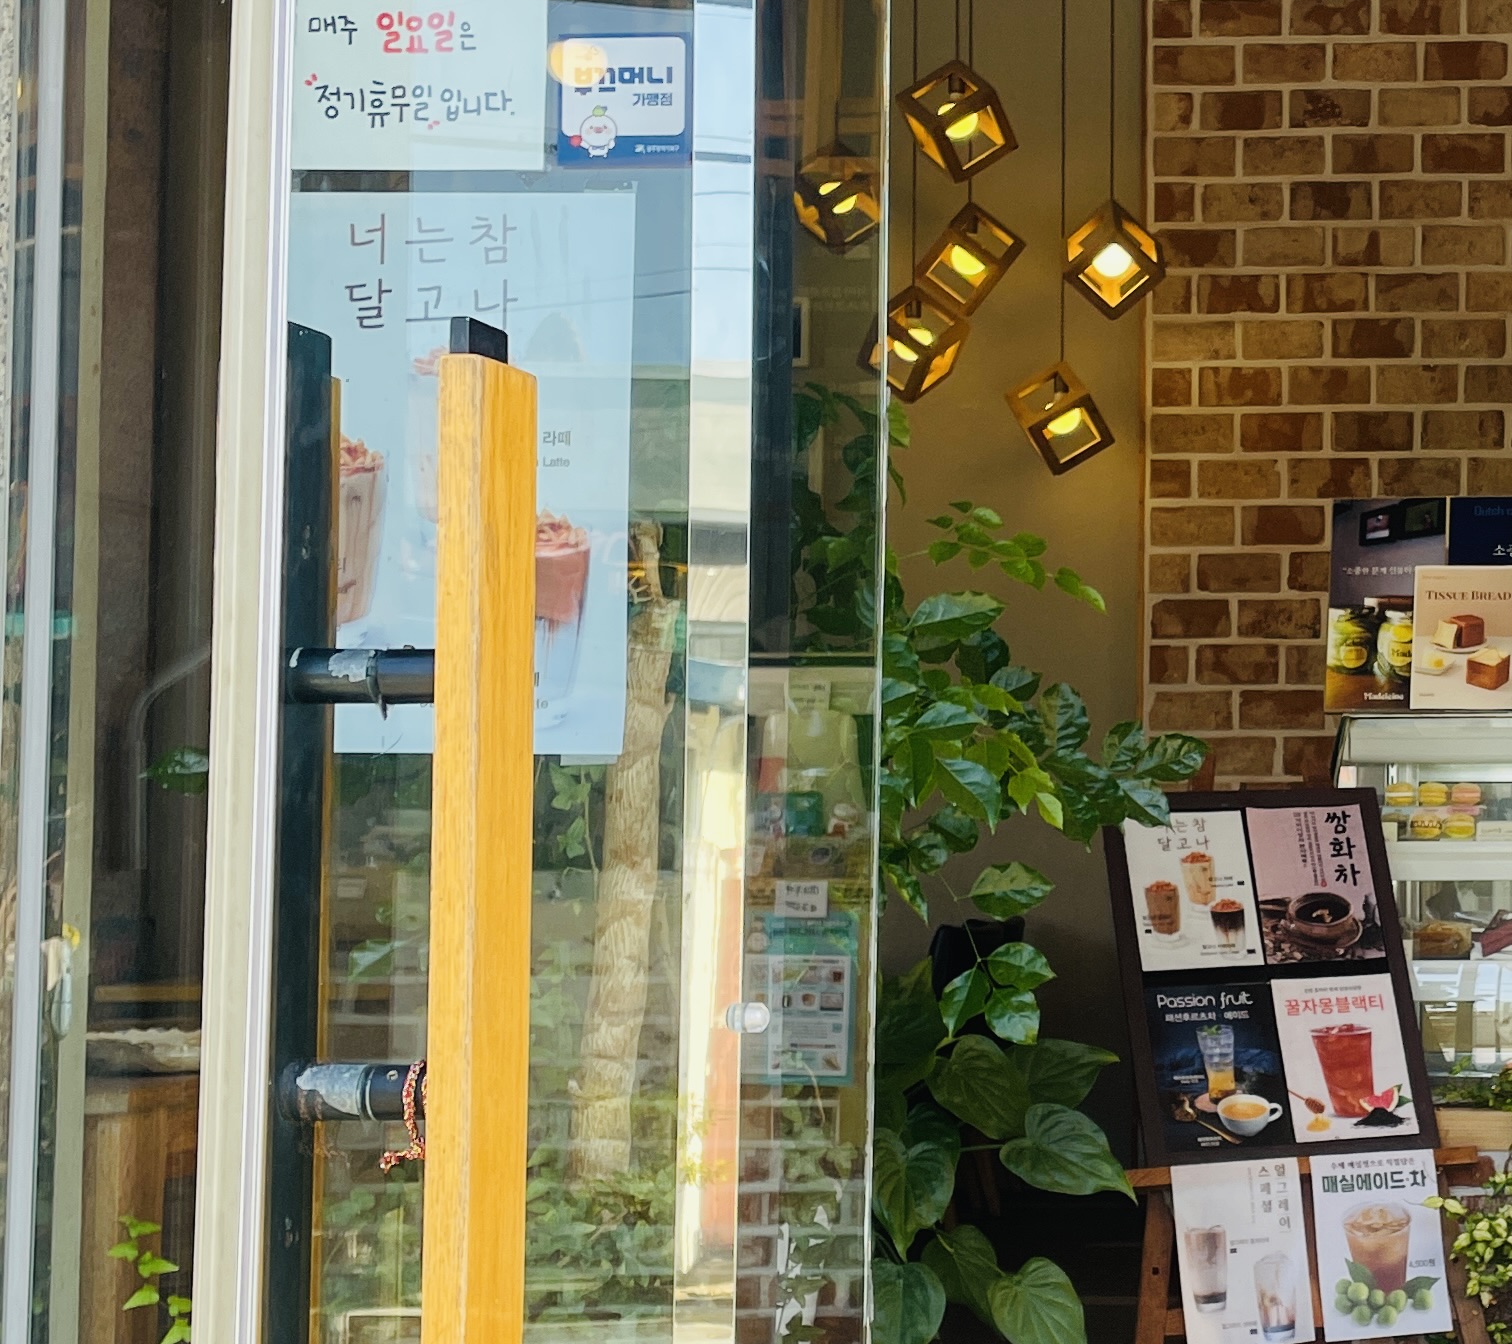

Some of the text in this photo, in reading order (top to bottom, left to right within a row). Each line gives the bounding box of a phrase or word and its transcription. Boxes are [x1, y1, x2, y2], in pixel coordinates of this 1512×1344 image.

[307, 11, 477, 54] 매주 일요일은
[631, 92, 673, 107] 가맹점
[1425, 590, 1512, 602] TISSUE BREAD
[1324, 810, 1361, 887] 쌍화차
[1157, 991, 1254, 1009] Passion fruit
[1285, 993, 1384, 1017] 꿀자몽블랙티
